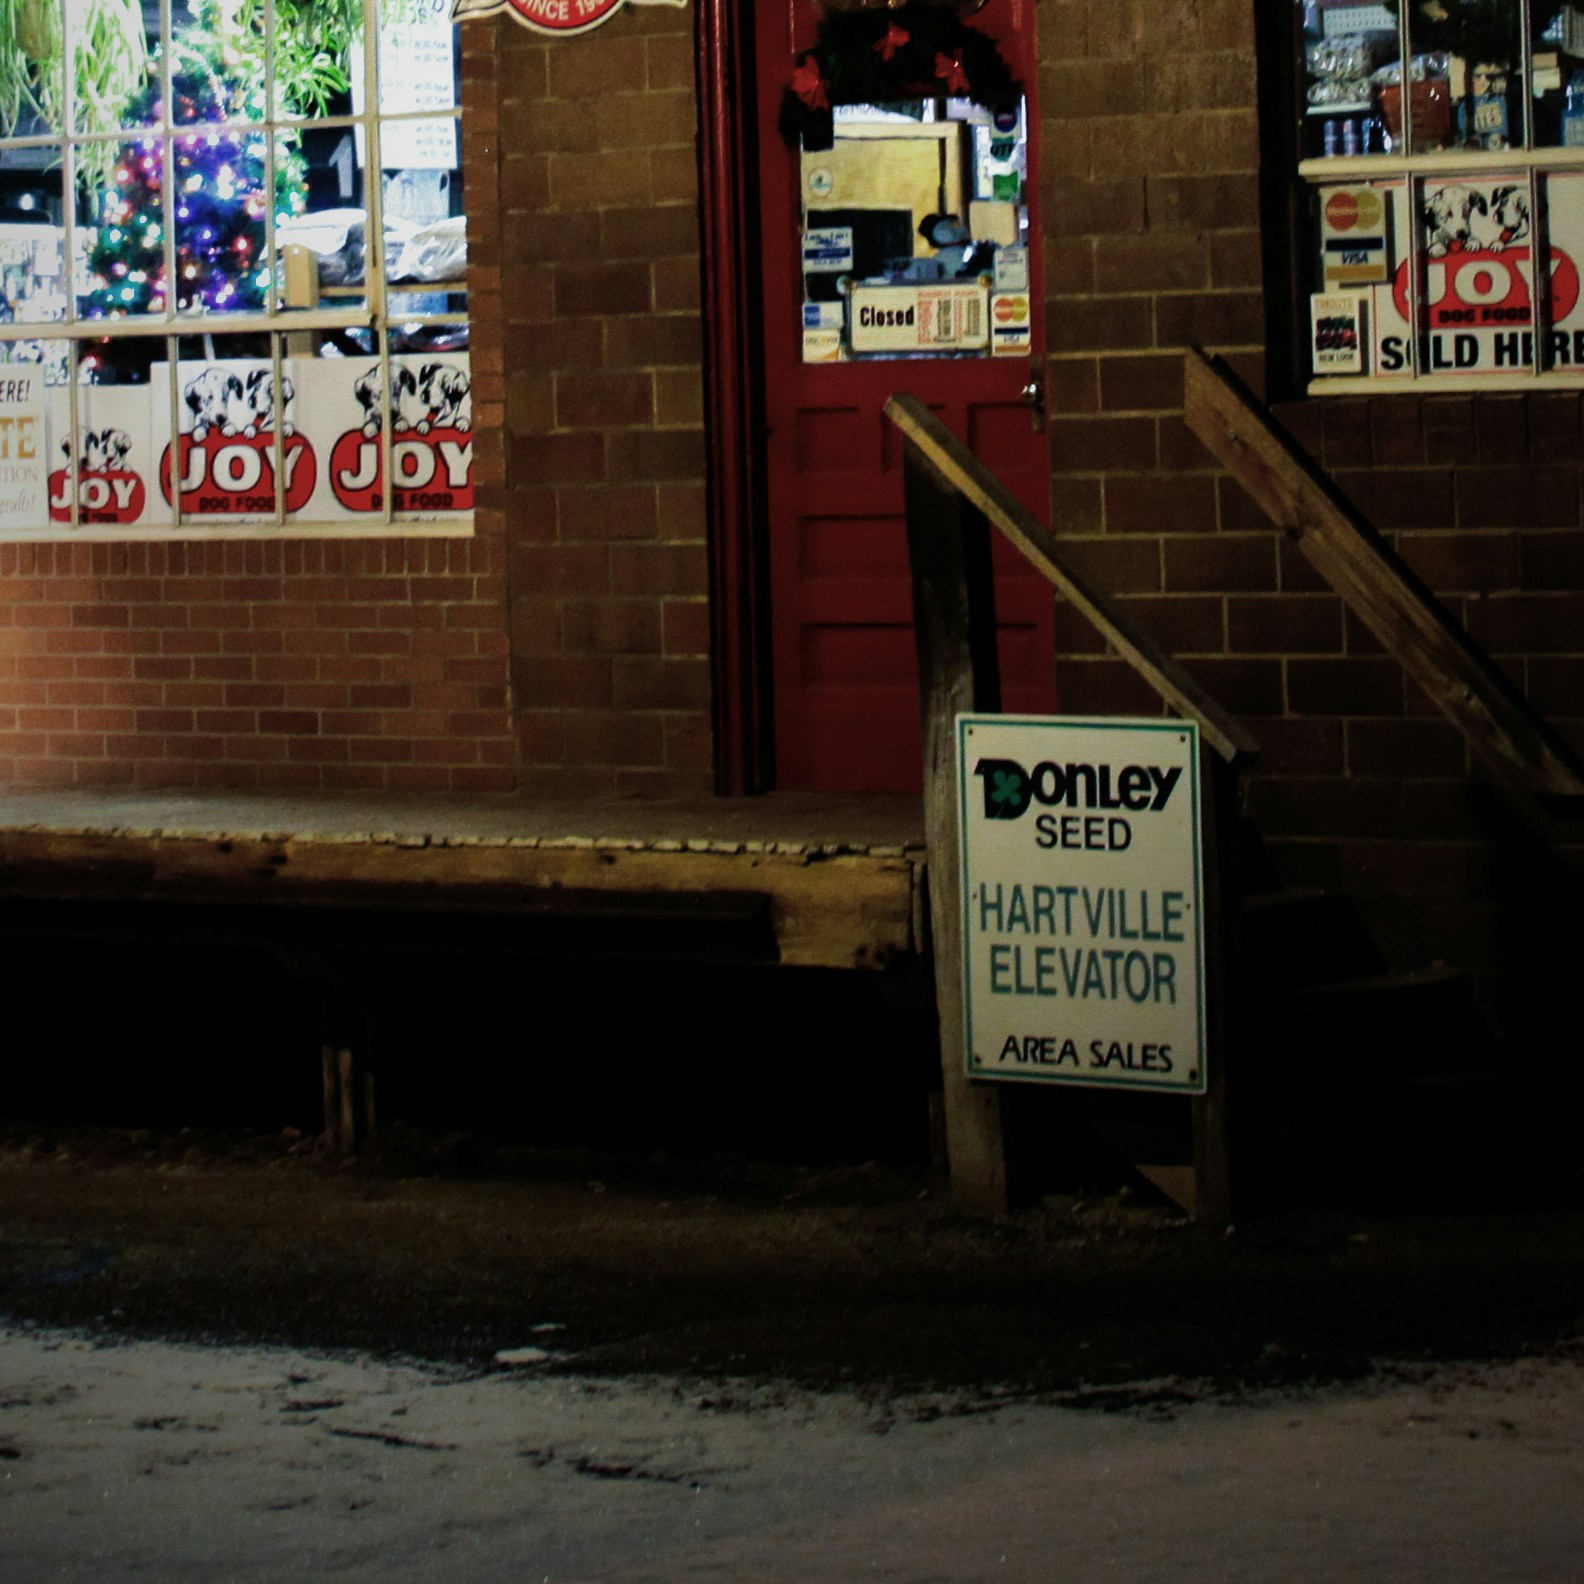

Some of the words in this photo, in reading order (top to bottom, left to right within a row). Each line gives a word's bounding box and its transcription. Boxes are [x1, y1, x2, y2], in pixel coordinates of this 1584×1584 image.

[859, 305, 915, 327] Closed
[170, 444, 305, 493] JOY
[340, 440, 473, 490] JOY
[50, 476, 137, 511] JOY
[199, 495, 231, 512] DOG
[371, 493, 405, 510] DG
[409, 492, 454, 508] FOOD
[1035, 814, 1132, 851] SEED
[978, 882, 1185, 942] HARTVILLE
[989, 943, 1178, 1005] ELEVATOR
[998, 1035, 1080, 1066] AREA
[1089, 1039, 1174, 1072] SALES
